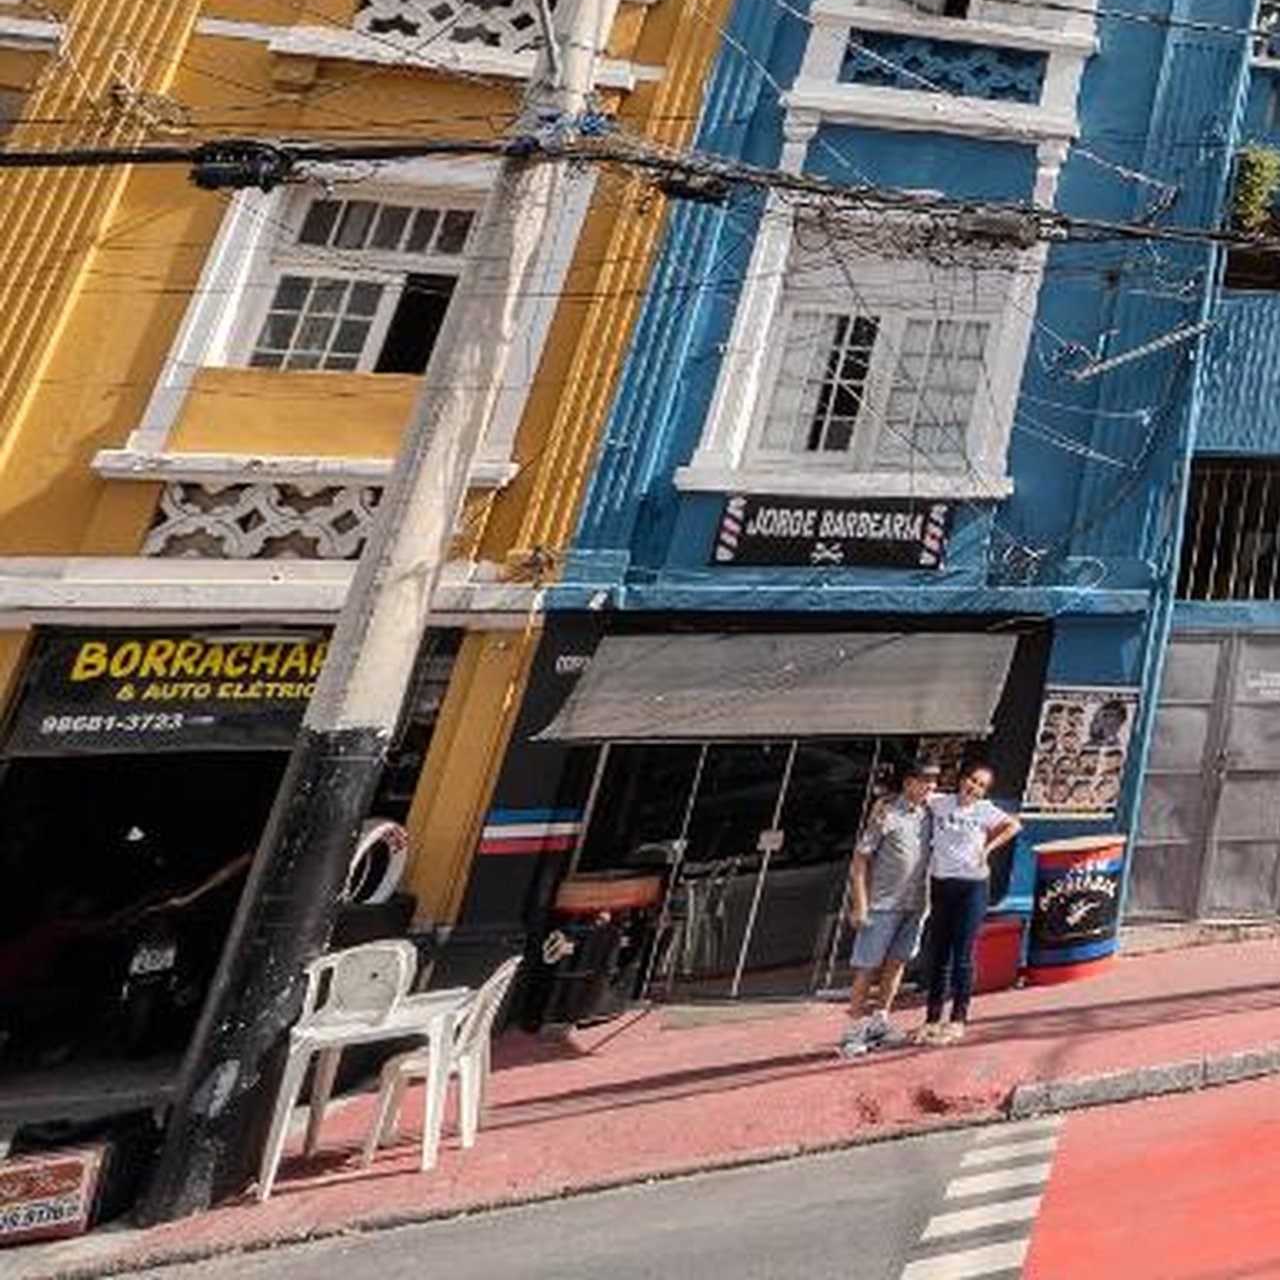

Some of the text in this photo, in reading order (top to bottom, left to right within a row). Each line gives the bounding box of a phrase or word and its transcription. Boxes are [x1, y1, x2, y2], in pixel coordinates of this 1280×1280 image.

[746, 506, 925, 541] JORGE BARBEARIA
[116, 682, 136, 701] &
[141, 681, 212, 701] AUTO
